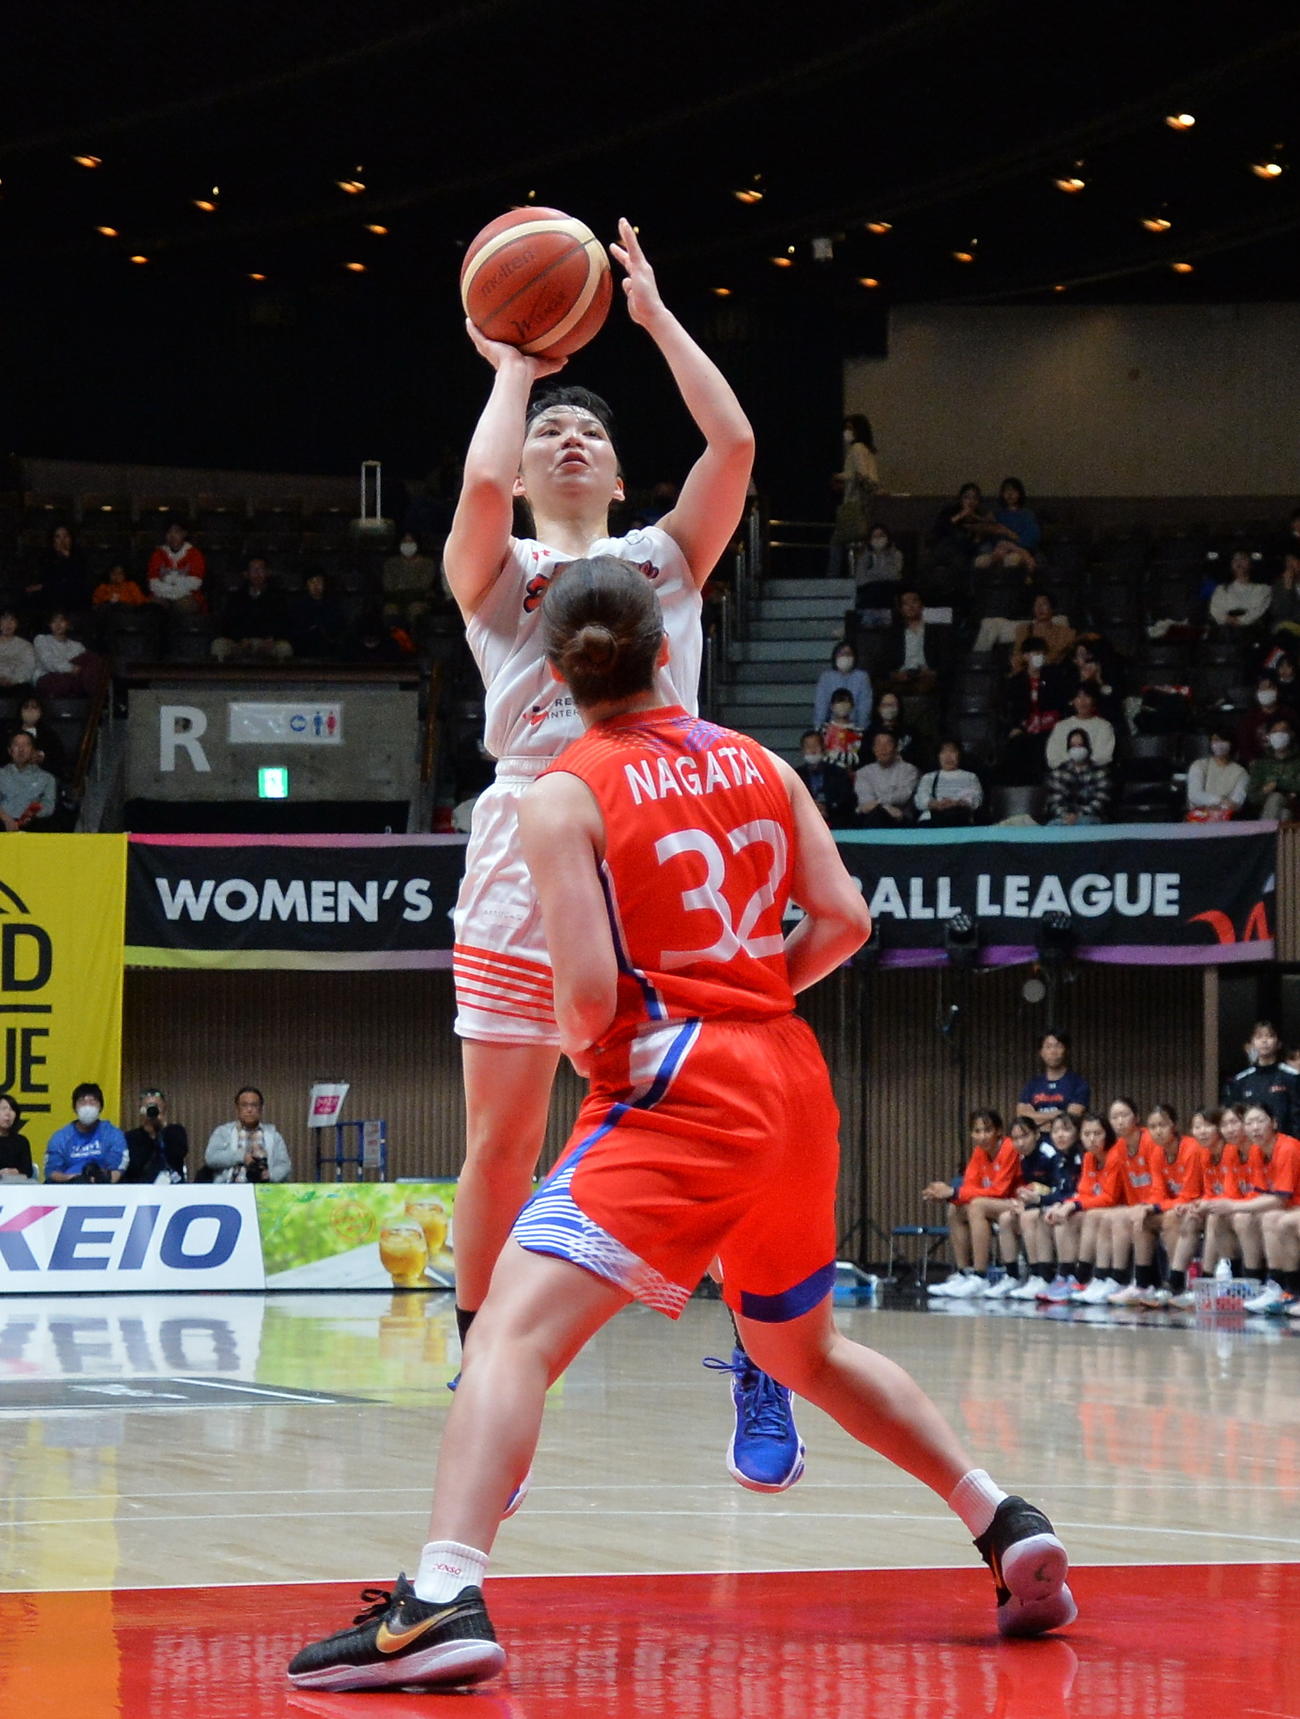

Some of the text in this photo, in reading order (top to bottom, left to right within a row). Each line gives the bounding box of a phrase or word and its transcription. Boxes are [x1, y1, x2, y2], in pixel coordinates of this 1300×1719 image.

[160, 706, 211, 772] R
[624, 746, 765, 805] NAGATA
[155, 878, 433, 922] WOMEN'S
[654, 819, 788, 970] 32
[850, 875, 961, 919] ALL
[976, 873, 1180, 917] LEAGUE
[0, 1204, 242, 1271] KEIO
